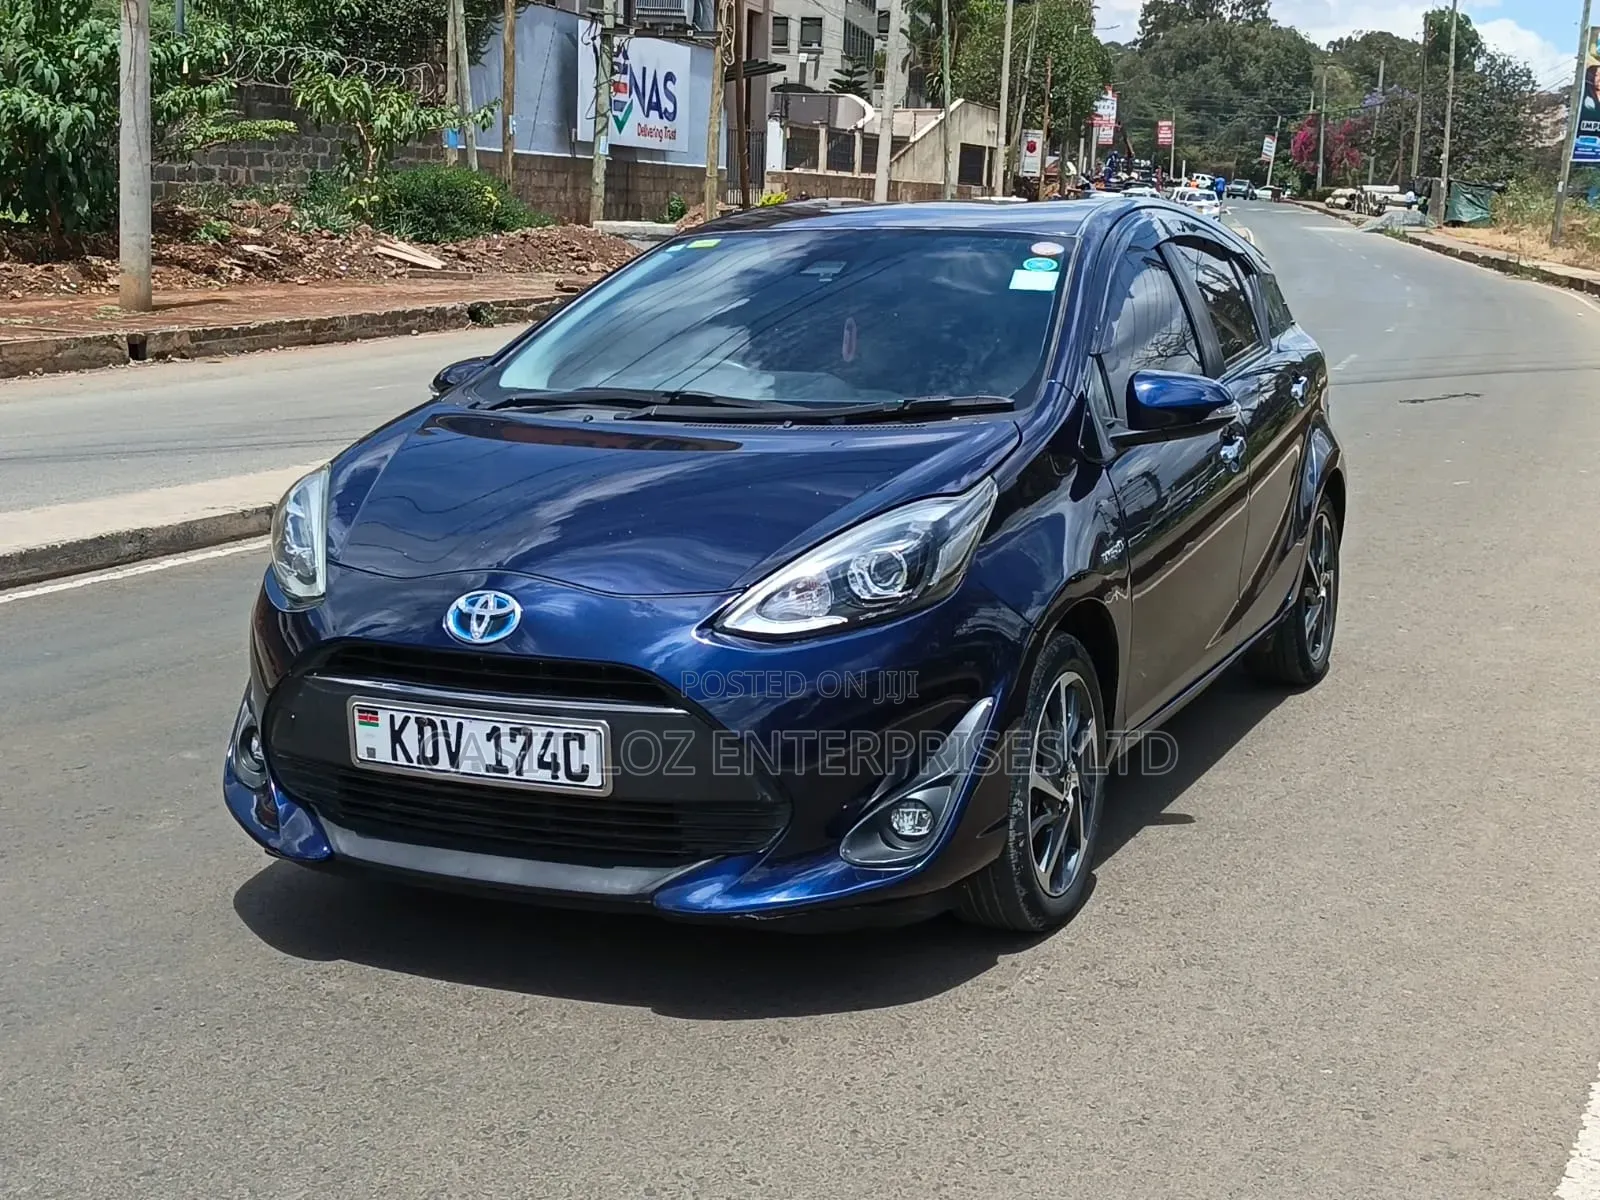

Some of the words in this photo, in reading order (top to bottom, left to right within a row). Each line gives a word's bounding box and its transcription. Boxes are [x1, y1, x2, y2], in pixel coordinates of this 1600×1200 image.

[609, 60, 678, 122] ENAS
[637, 122, 664, 142] Delivering
[664, 126, 677, 140] Trust
[1580, 120, 1600, 132] IMP
[389, 713, 464, 769] KDV
[485, 725, 590, 783] 174C
